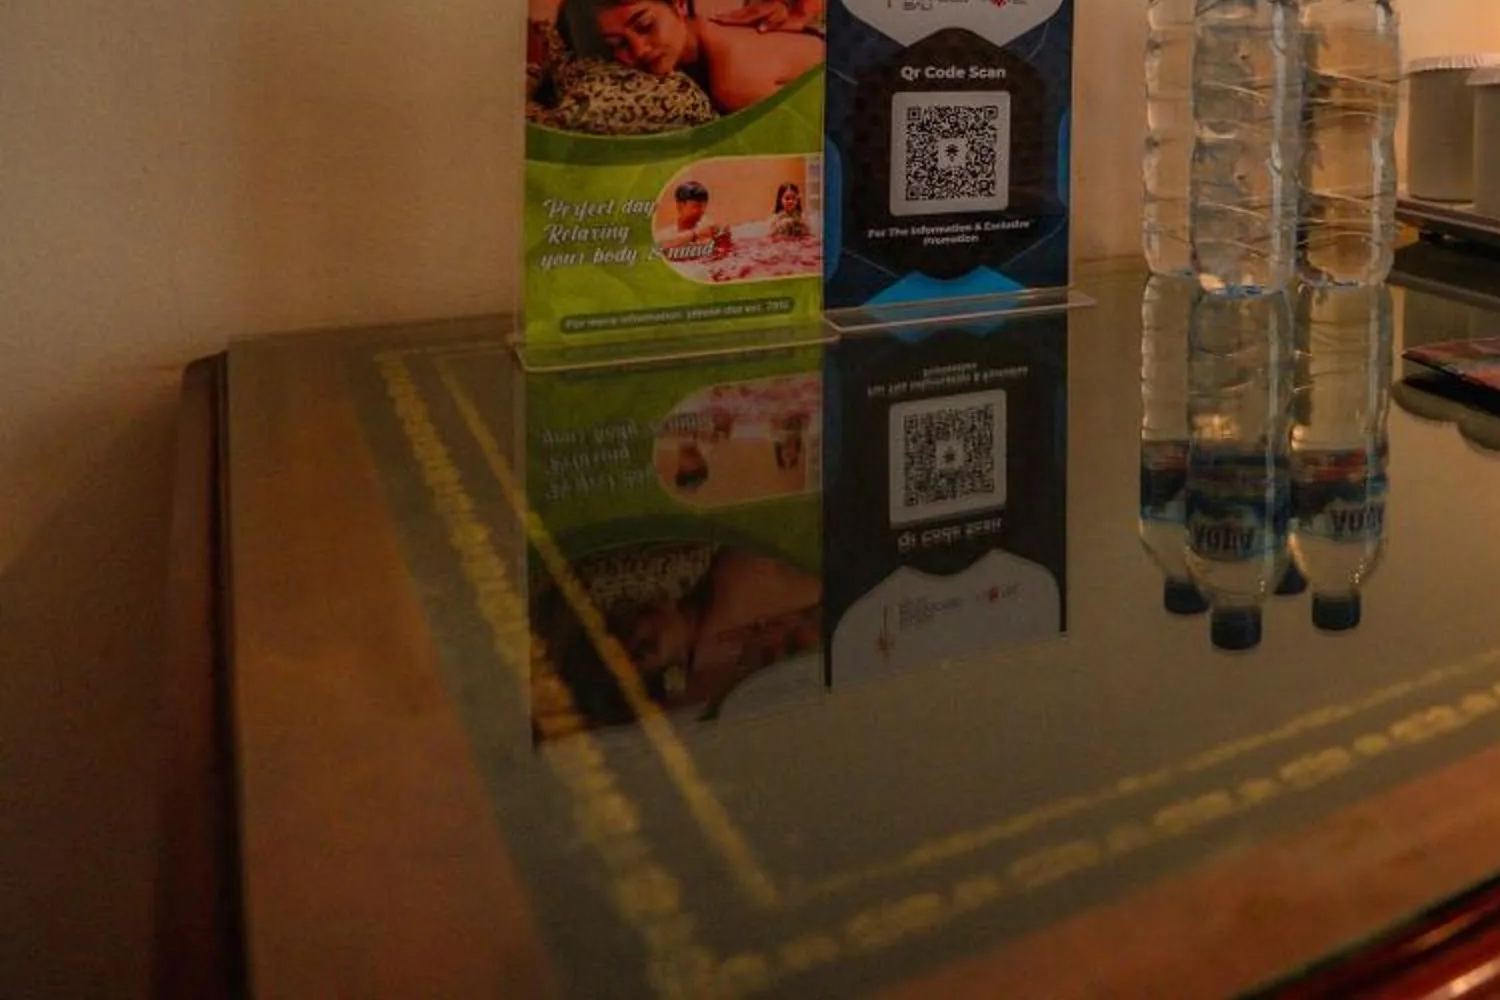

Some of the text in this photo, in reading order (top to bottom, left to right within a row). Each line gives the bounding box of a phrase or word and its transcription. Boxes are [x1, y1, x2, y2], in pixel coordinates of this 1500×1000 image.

[900, 65, 1007, 80] Qr Code Scan
[543, 198, 655, 221] Perfect day
[544, 223, 630, 245] Relaxing
[889, 227, 909, 237] The
[541, 252, 584, 270] your
[594, 247, 638, 267] body
